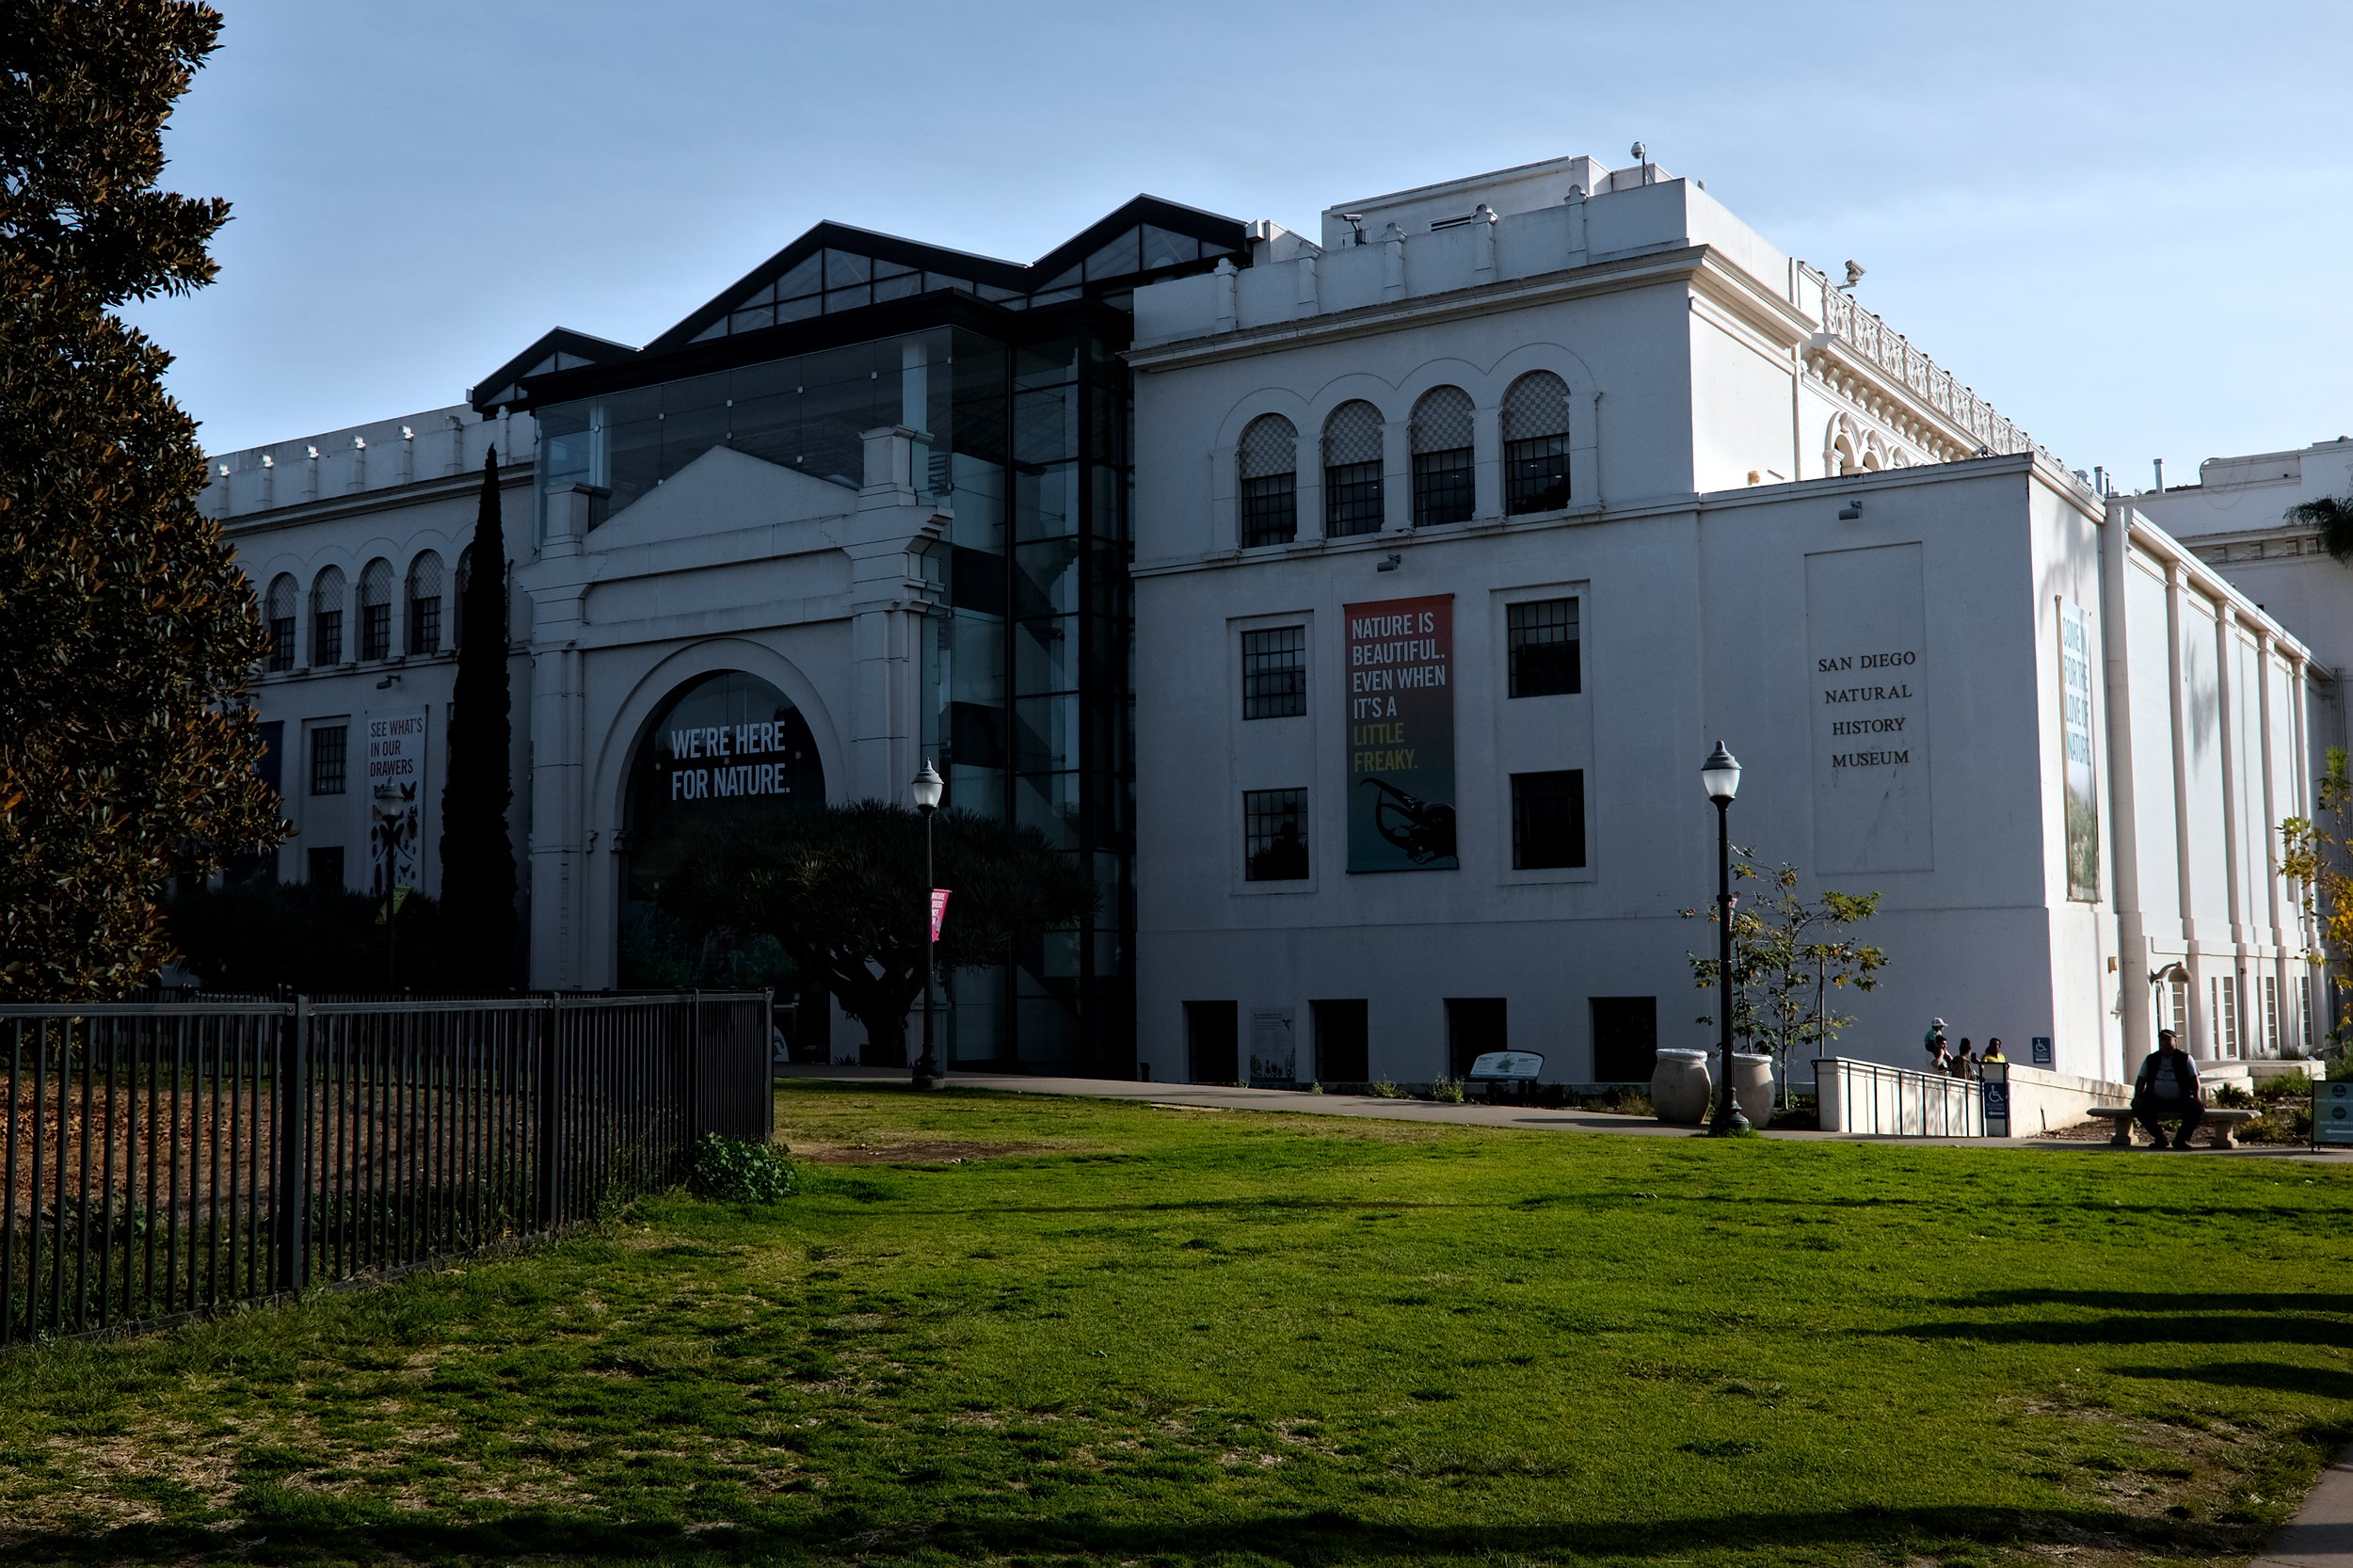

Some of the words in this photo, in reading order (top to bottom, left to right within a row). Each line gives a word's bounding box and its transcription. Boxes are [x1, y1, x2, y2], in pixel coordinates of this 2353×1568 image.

[1352, 614, 1413, 640] NATURE
[1418, 612, 1434, 633] IS
[2062, 616, 2081, 653] COME
[1353, 638, 1445, 666] BEAUTIFUL.
[1818, 656, 1853, 673] SAN
[1860, 650, 1916, 669] DIEGO
[1353, 669, 1393, 693] EVEN
[1397, 664, 1446, 689] WHEN
[2063, 654, 2078, 688] FOR
[2077, 660, 2089, 694] THE
[1824, 684, 1913, 704] NATURAL
[1353, 696, 1383, 719] IT'S
[1386, 696, 1398, 717] A
[2065, 692, 2082, 727] LOVE
[2081, 698, 2089, 730] OF
[371, 721, 387, 737] SEE
[390, 717, 423, 735] WHAT'S
[1353, 722, 1404, 746] LITTLE
[1832, 717, 1906, 736] HISTORY
[371, 742, 380, 758] IN
[382, 740, 401, 757] OUR
[671, 726, 730, 760] WE'RE
[736, 720, 785, 755] HERE
[370, 759, 413, 777] DRAWERS
[1354, 748, 1418, 774] FREAKY.
[1832, 749, 1911, 768] MUSEUM
[672, 769, 709, 801] FOR
[713, 762, 791, 798] NATURE.
